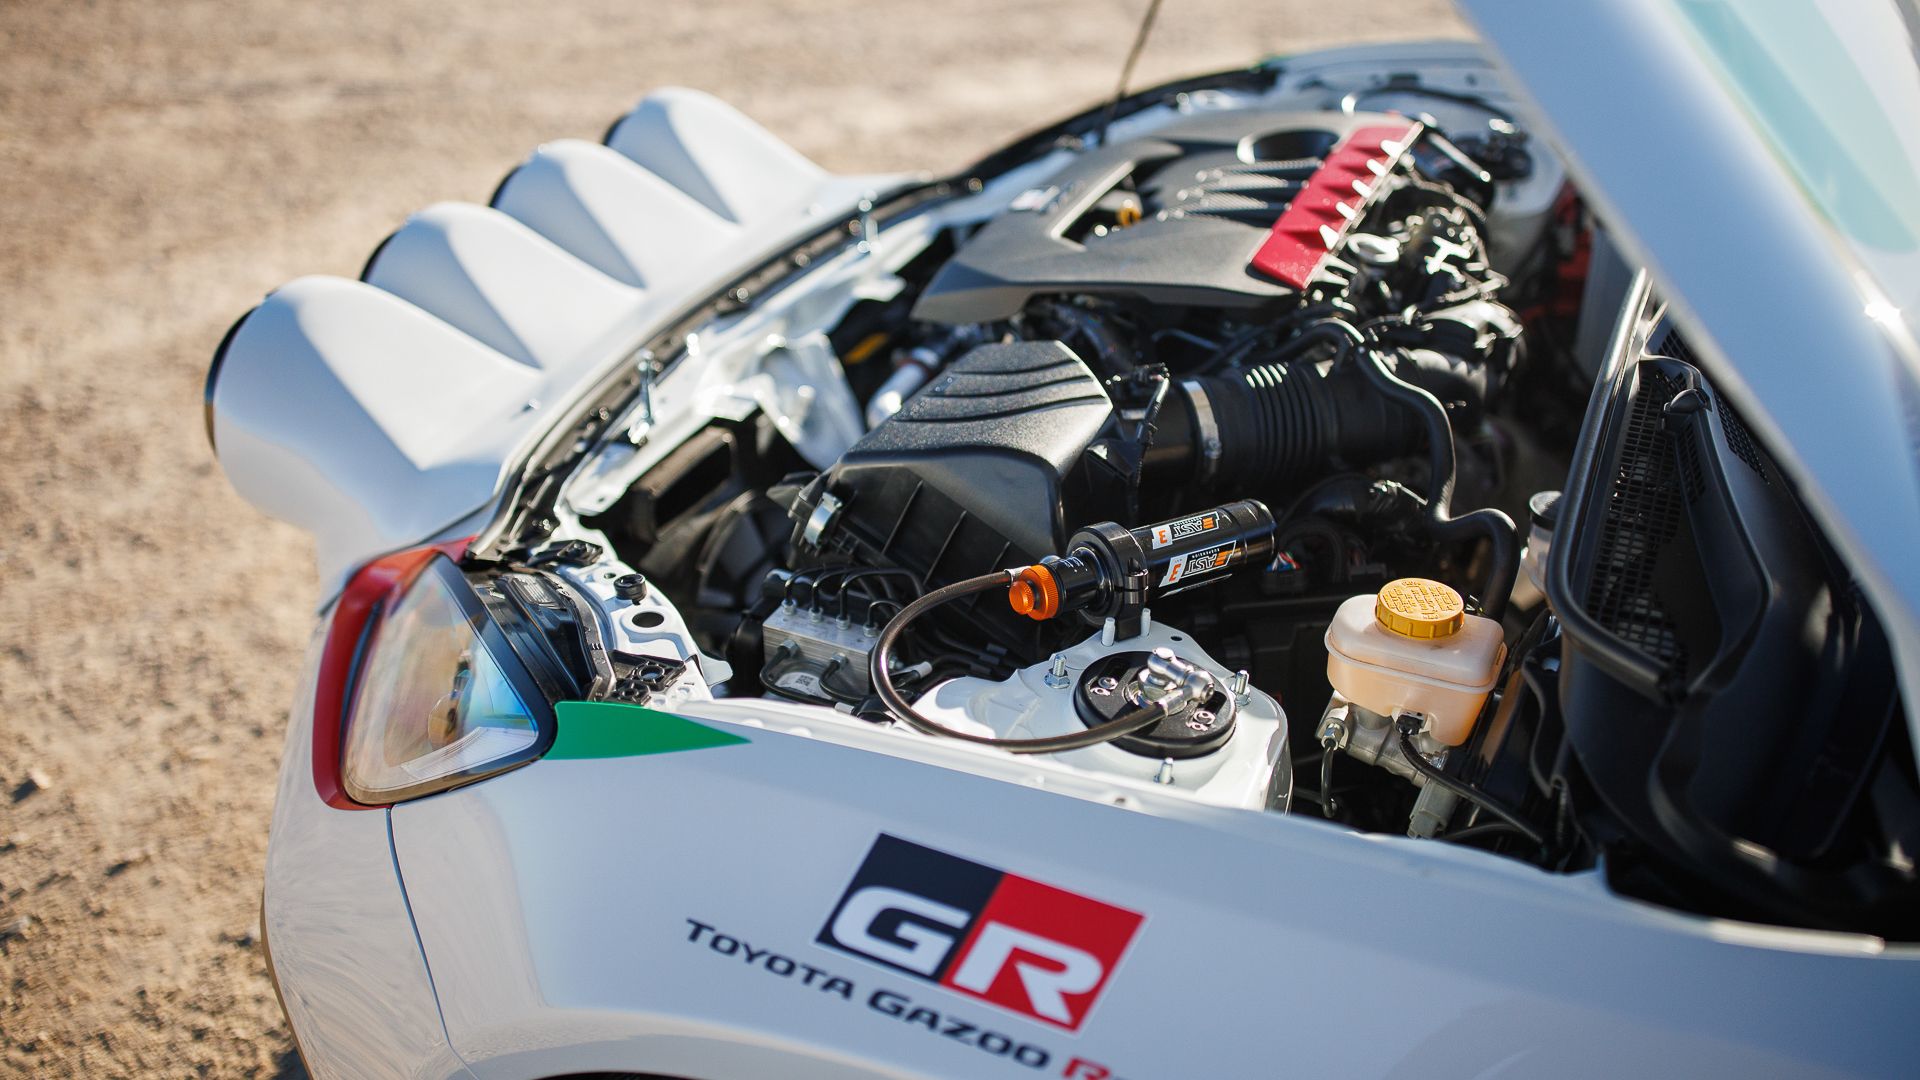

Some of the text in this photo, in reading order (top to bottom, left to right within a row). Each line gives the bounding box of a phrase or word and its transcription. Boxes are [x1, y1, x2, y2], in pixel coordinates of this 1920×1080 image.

[1168, 553, 1218, 582] AST 3
[686, 918, 1126, 1080] TOYOTA GAZOO R
[831, 885, 1103, 1026] GR
